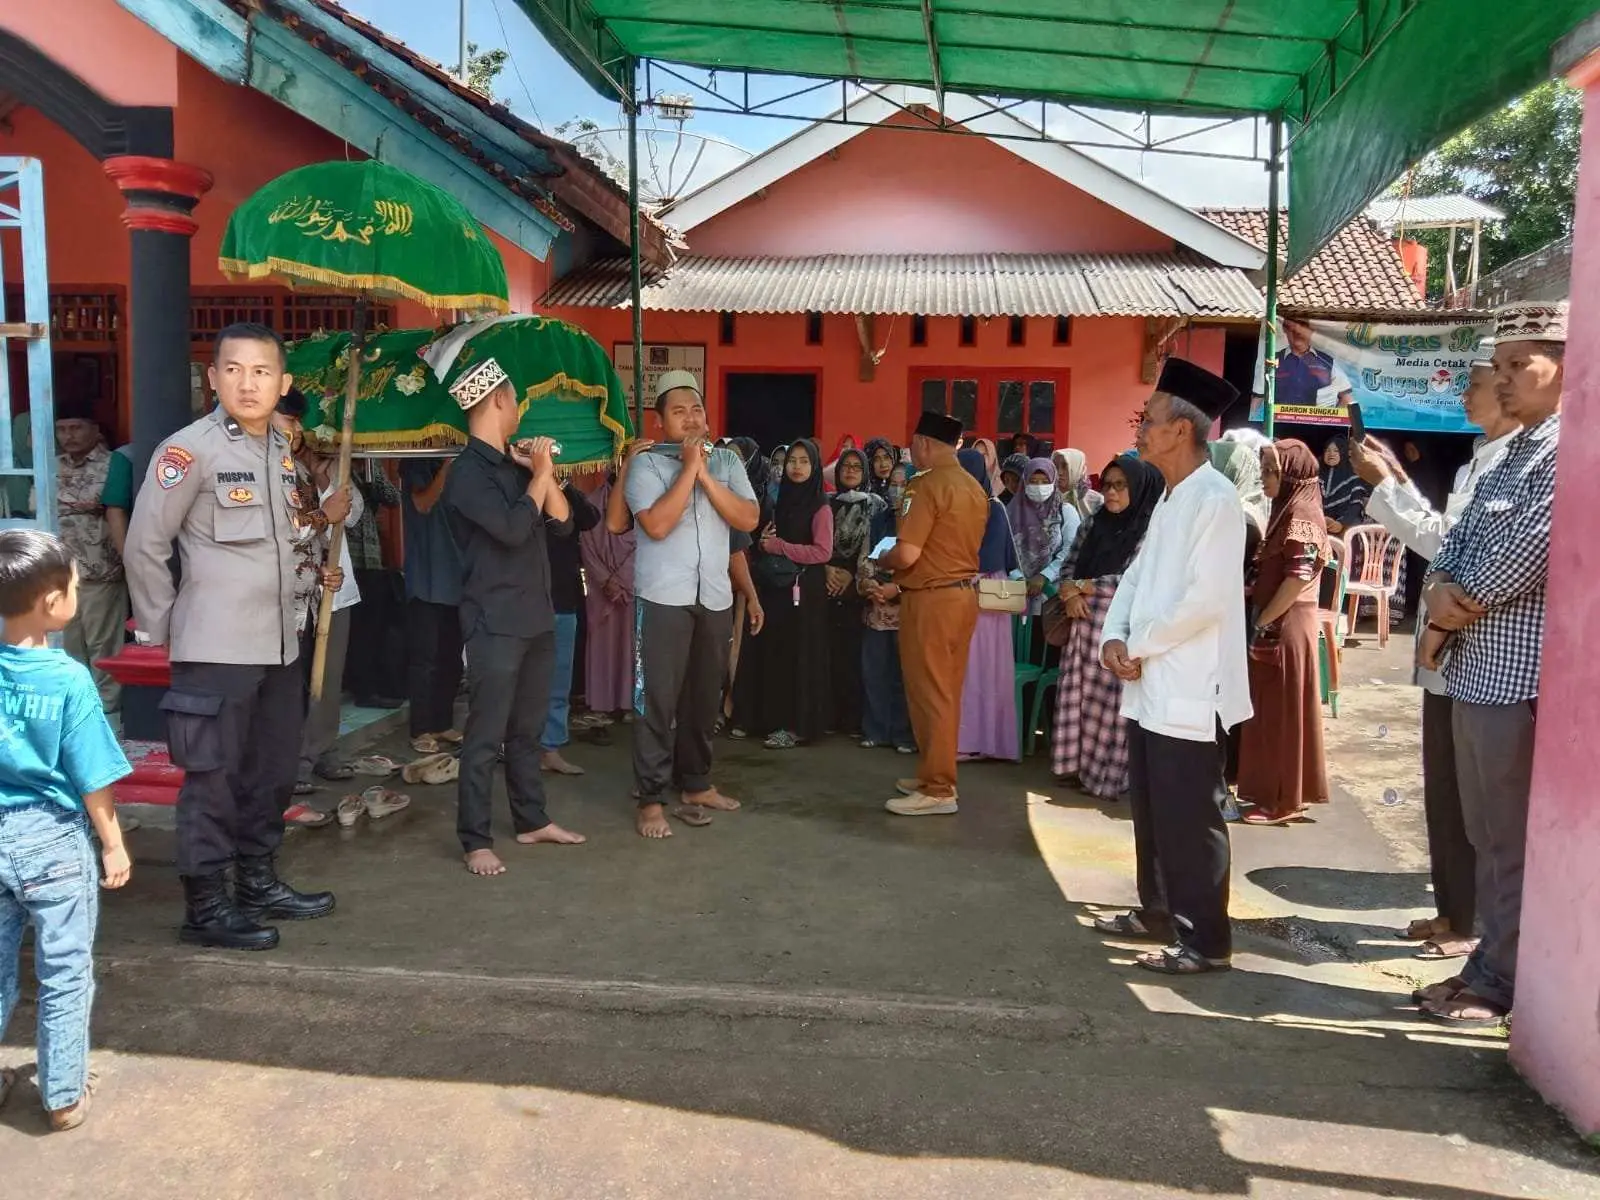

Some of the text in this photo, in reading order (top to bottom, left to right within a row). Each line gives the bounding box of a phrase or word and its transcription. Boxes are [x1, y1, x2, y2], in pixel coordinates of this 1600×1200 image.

[1396, 358, 1429, 367] Media
[1434, 359, 1466, 368] Cetak
[1362, 367, 1428, 397] Tugas
[1280, 406, 1339, 416] DAHRON SUNGKAI
[217, 471, 256, 483] RUSPAN
[281, 474, 297, 484] POL
